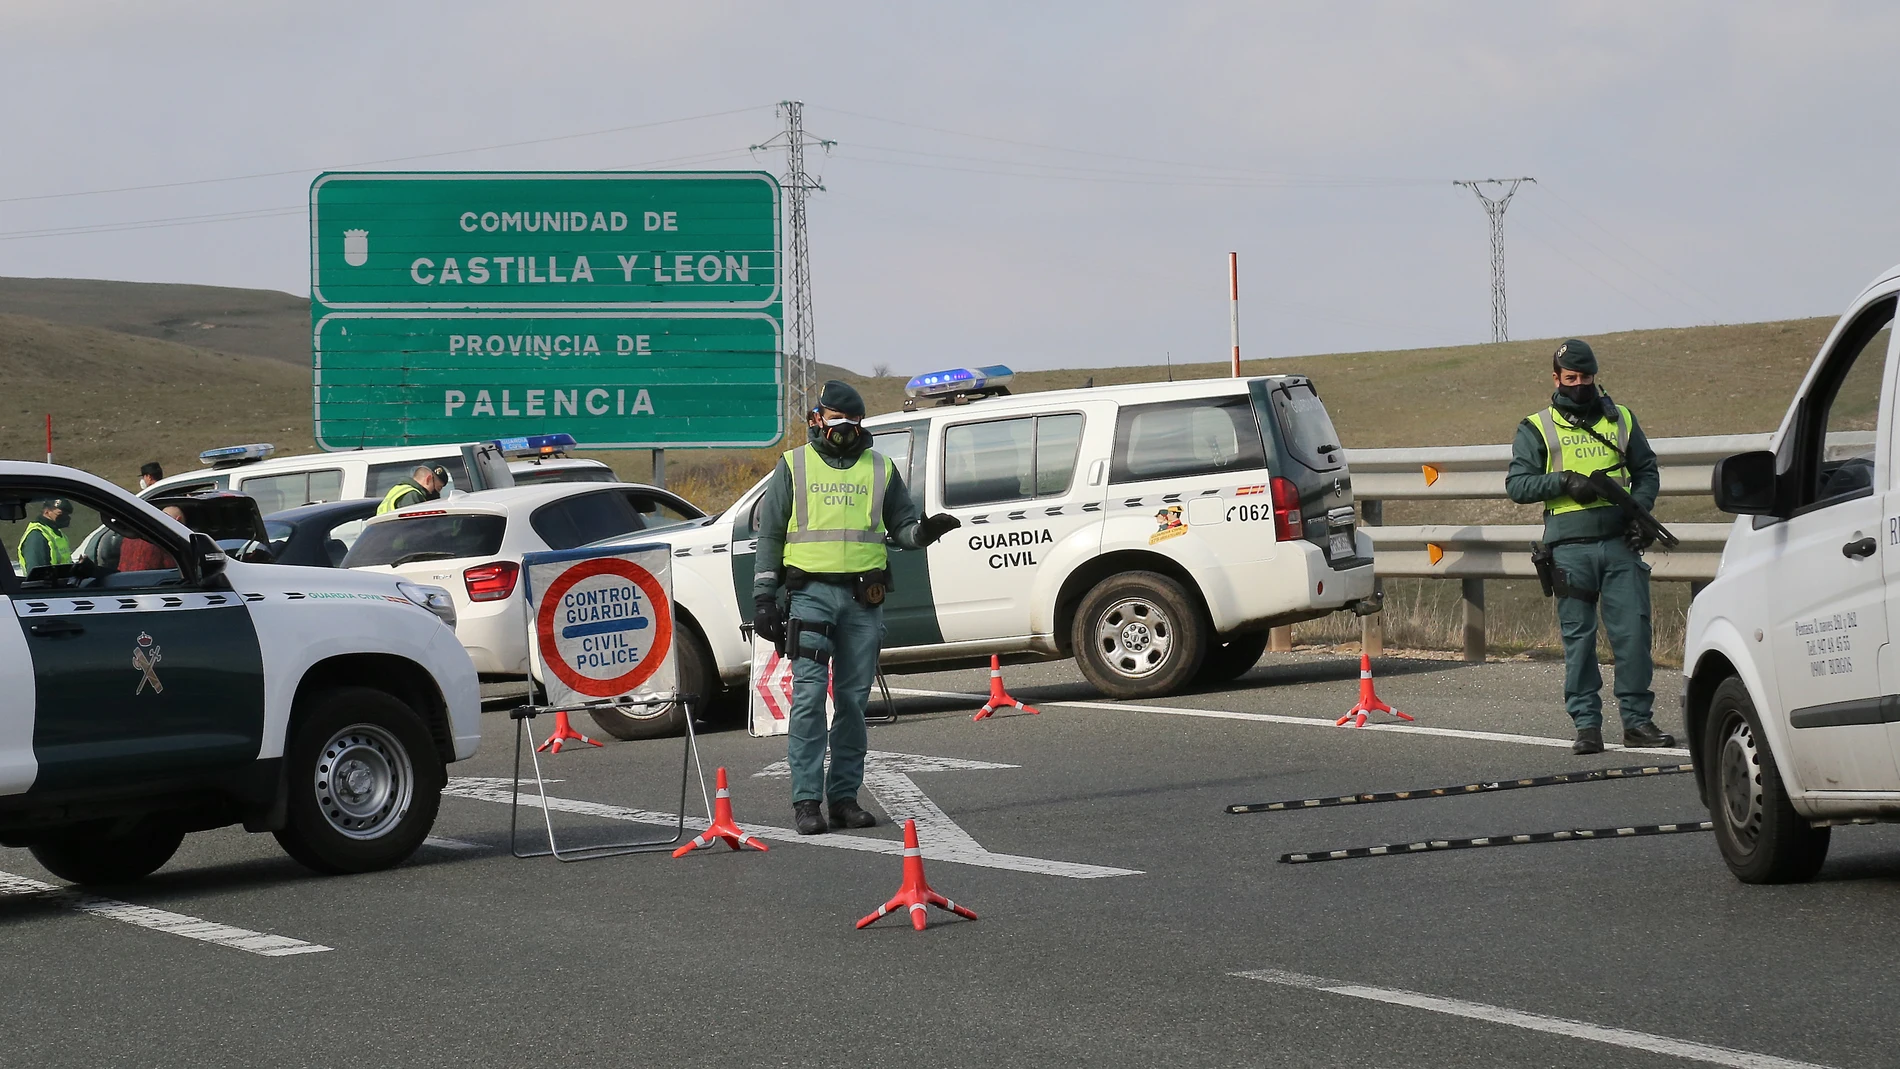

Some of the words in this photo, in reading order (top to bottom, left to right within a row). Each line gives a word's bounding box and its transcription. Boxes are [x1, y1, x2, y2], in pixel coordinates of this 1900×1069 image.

[460, 211, 628, 232] COMUNIDAD
[644, 211, 678, 231] DE
[410, 256, 594, 285] CASTILLA
[617, 255, 638, 283] Y
[654, 254, 749, 283] LEON
[449, 335, 601, 359] PROVINCIA
[617, 334, 652, 356] DE
[445, 388, 655, 417] PALENCIA
[1575, 446, 1608, 458] CIVIL
[810, 483, 868, 495] GUARDIA
[823, 496, 855, 506] CIVIL
[1239, 503, 1270, 522] 062
[968, 528, 1053, 551] GUARDIA
[988, 550, 1037, 569] CIVIL
[357, 593, 384, 601] CIVIL
[564, 585, 642, 608] CONTROL
[566, 601, 640, 624] GUARDIA
[583, 633, 629, 652] CIVIL
[576, 647, 639, 670] POLICE
